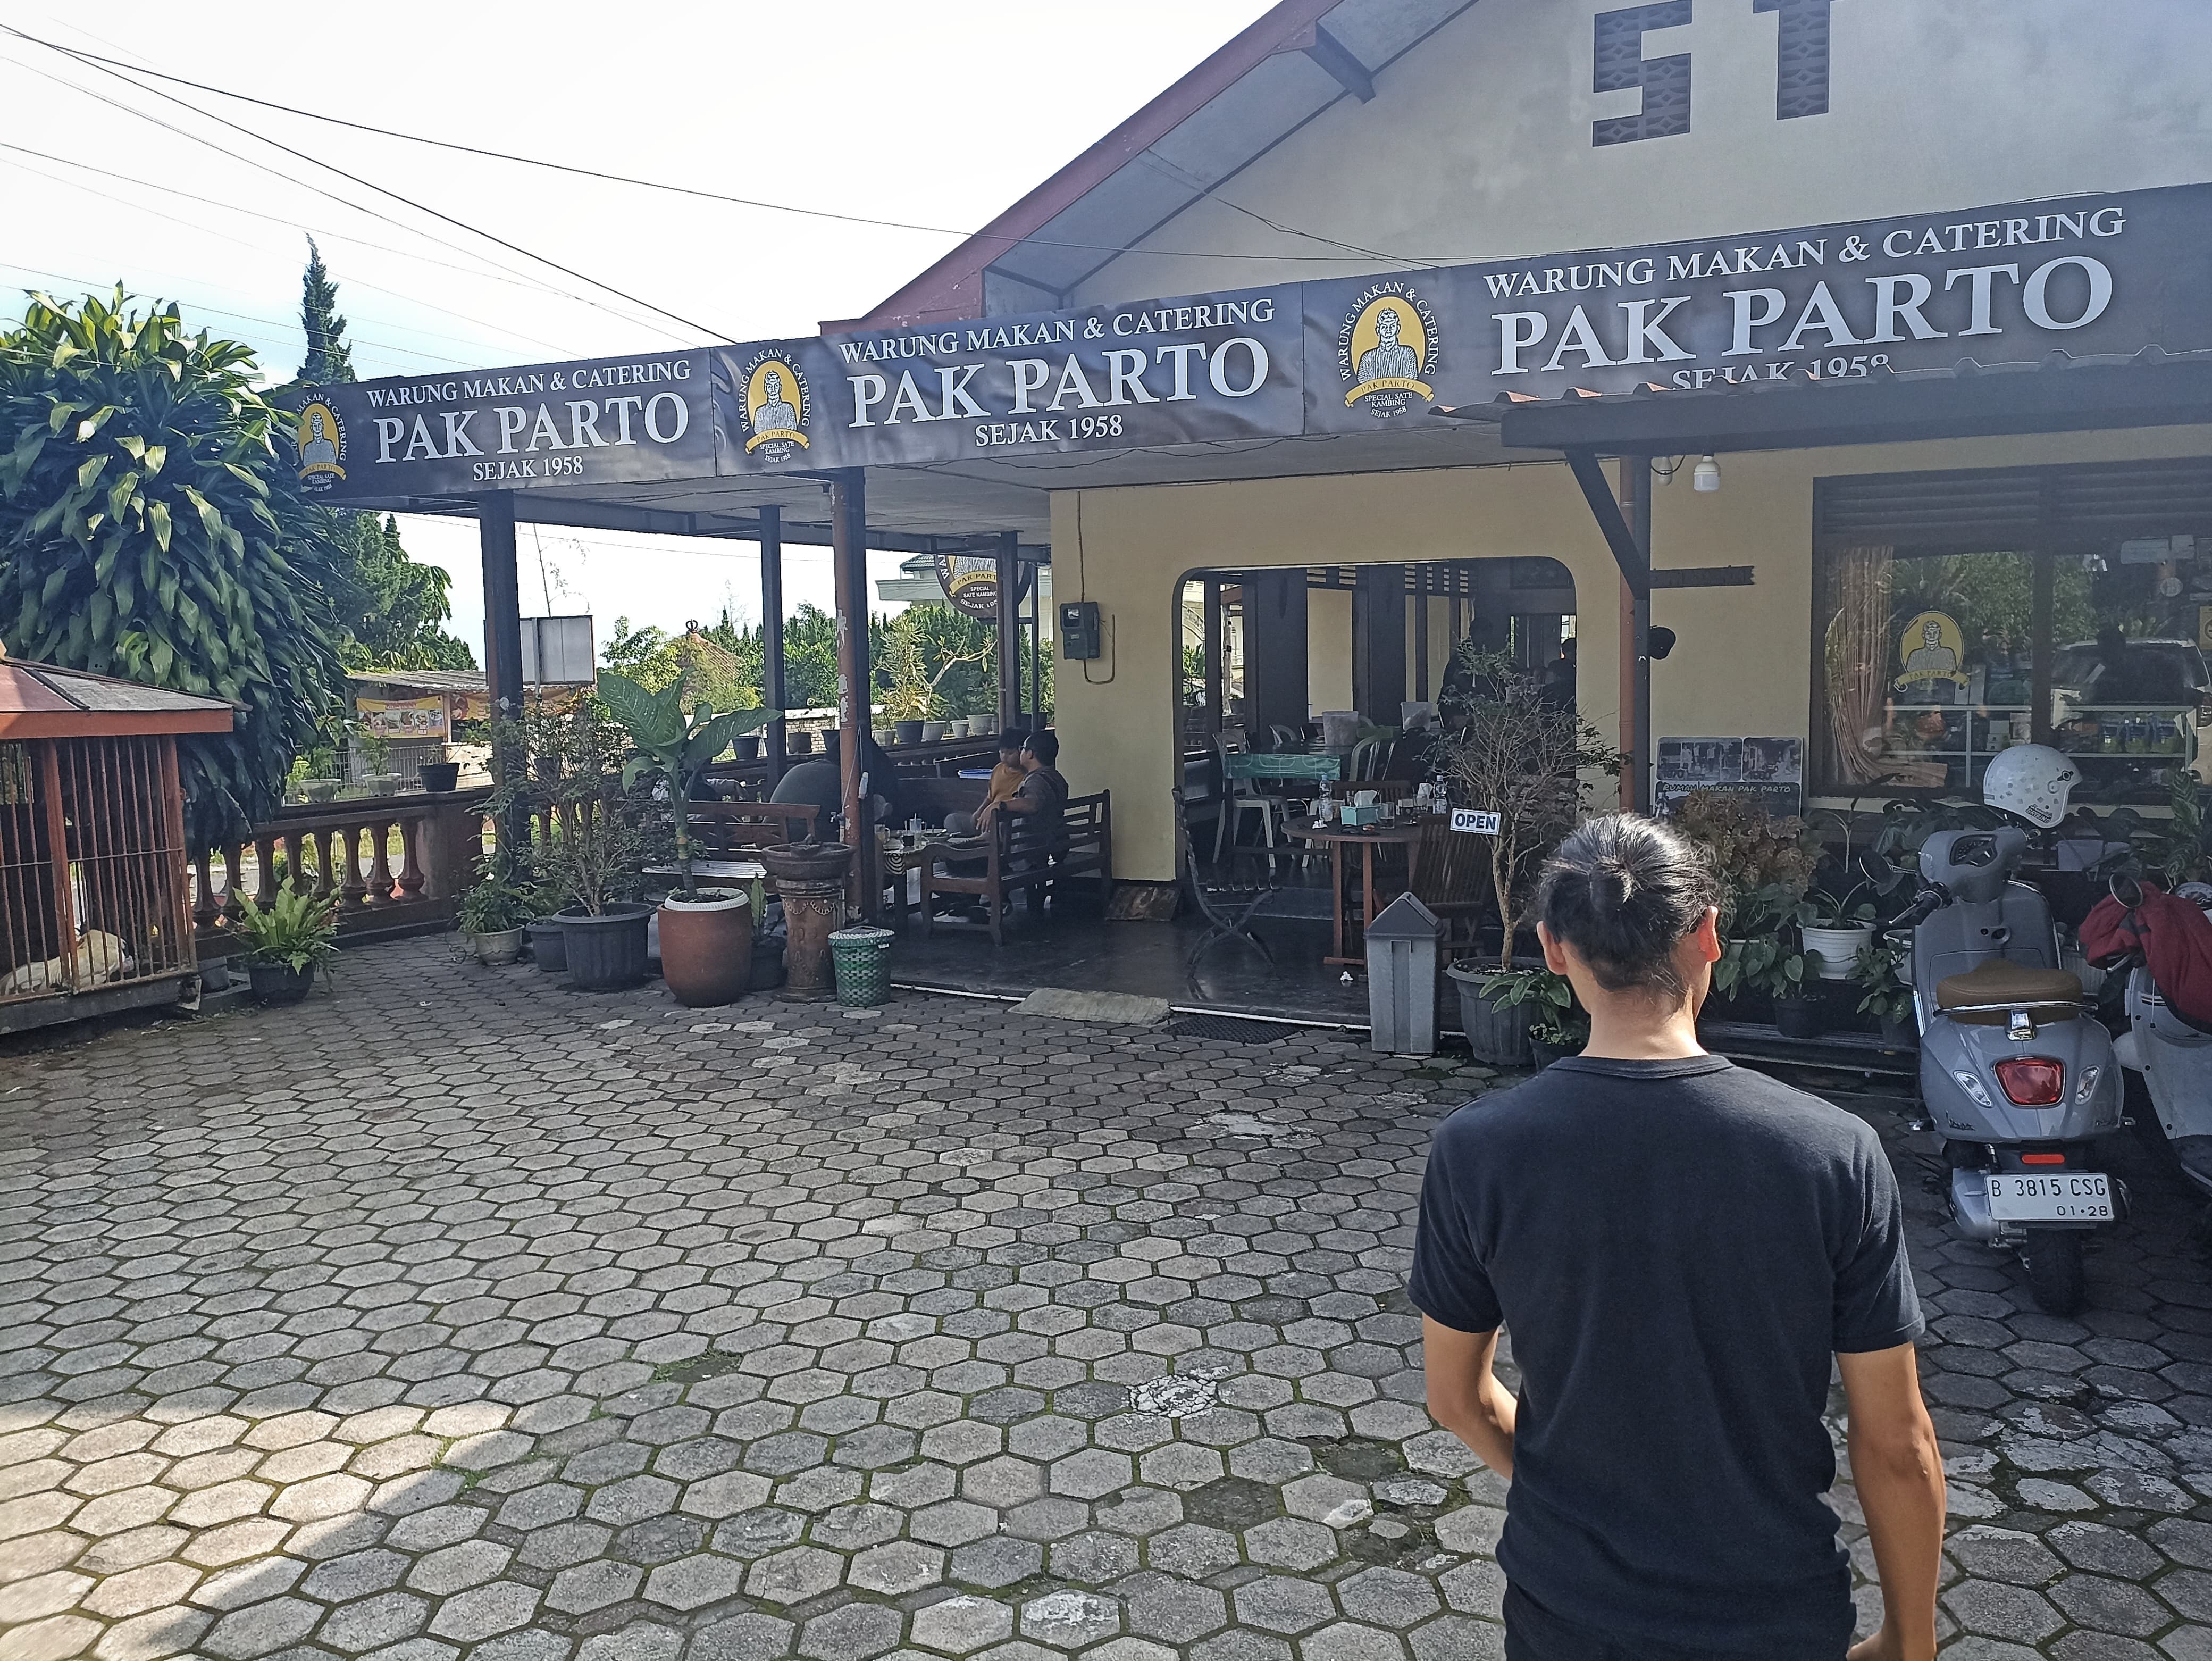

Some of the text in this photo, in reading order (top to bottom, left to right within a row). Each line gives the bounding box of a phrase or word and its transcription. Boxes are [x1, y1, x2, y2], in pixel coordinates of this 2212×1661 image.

[1483, 207, 2126, 298] WARUNG MAKAN & CATERING
[1491, 256, 2113, 376] PAK PARTO
[839, 297, 1275, 364] WARUNG MAKAN & CATERING
[1338, 281, 1439, 381] WARUNG MAKAN & CATERING
[367, 360, 691, 408] WARUNG MAKAN & CATERING
[739, 348, 811, 432] WARUNG MAKAN & CATERING
[847, 337, 1269, 427] PAK PARTO
[1361, 380, 1414, 394] PAK PARTO
[1364, 394, 1392, 402] SPECIAL
[1371, 399, 1406, 407] KAMBING
[1371, 406, 1407, 418] SEJAK 1958
[297, 393, 324, 414] MAKAN
[325, 397, 331, 407] &
[331, 405, 347, 461] CATERING
[373, 392, 689, 463] PAK PARTO
[757, 433, 769, 443] PAK
[975, 415, 1123, 446] SEJAK 1958
[473, 456, 583, 481] SEJAK 1958
[780, 453, 791, 462] 1958
[958, 575, 973, 585] PAK
[960, 599, 984, 609] SEJAK
[1909, 670, 1953, 680] PAK PARTO
[1455, 813, 1497, 830] OPEN
[1991, 1178, 2106, 1197] B 3815 CSG
